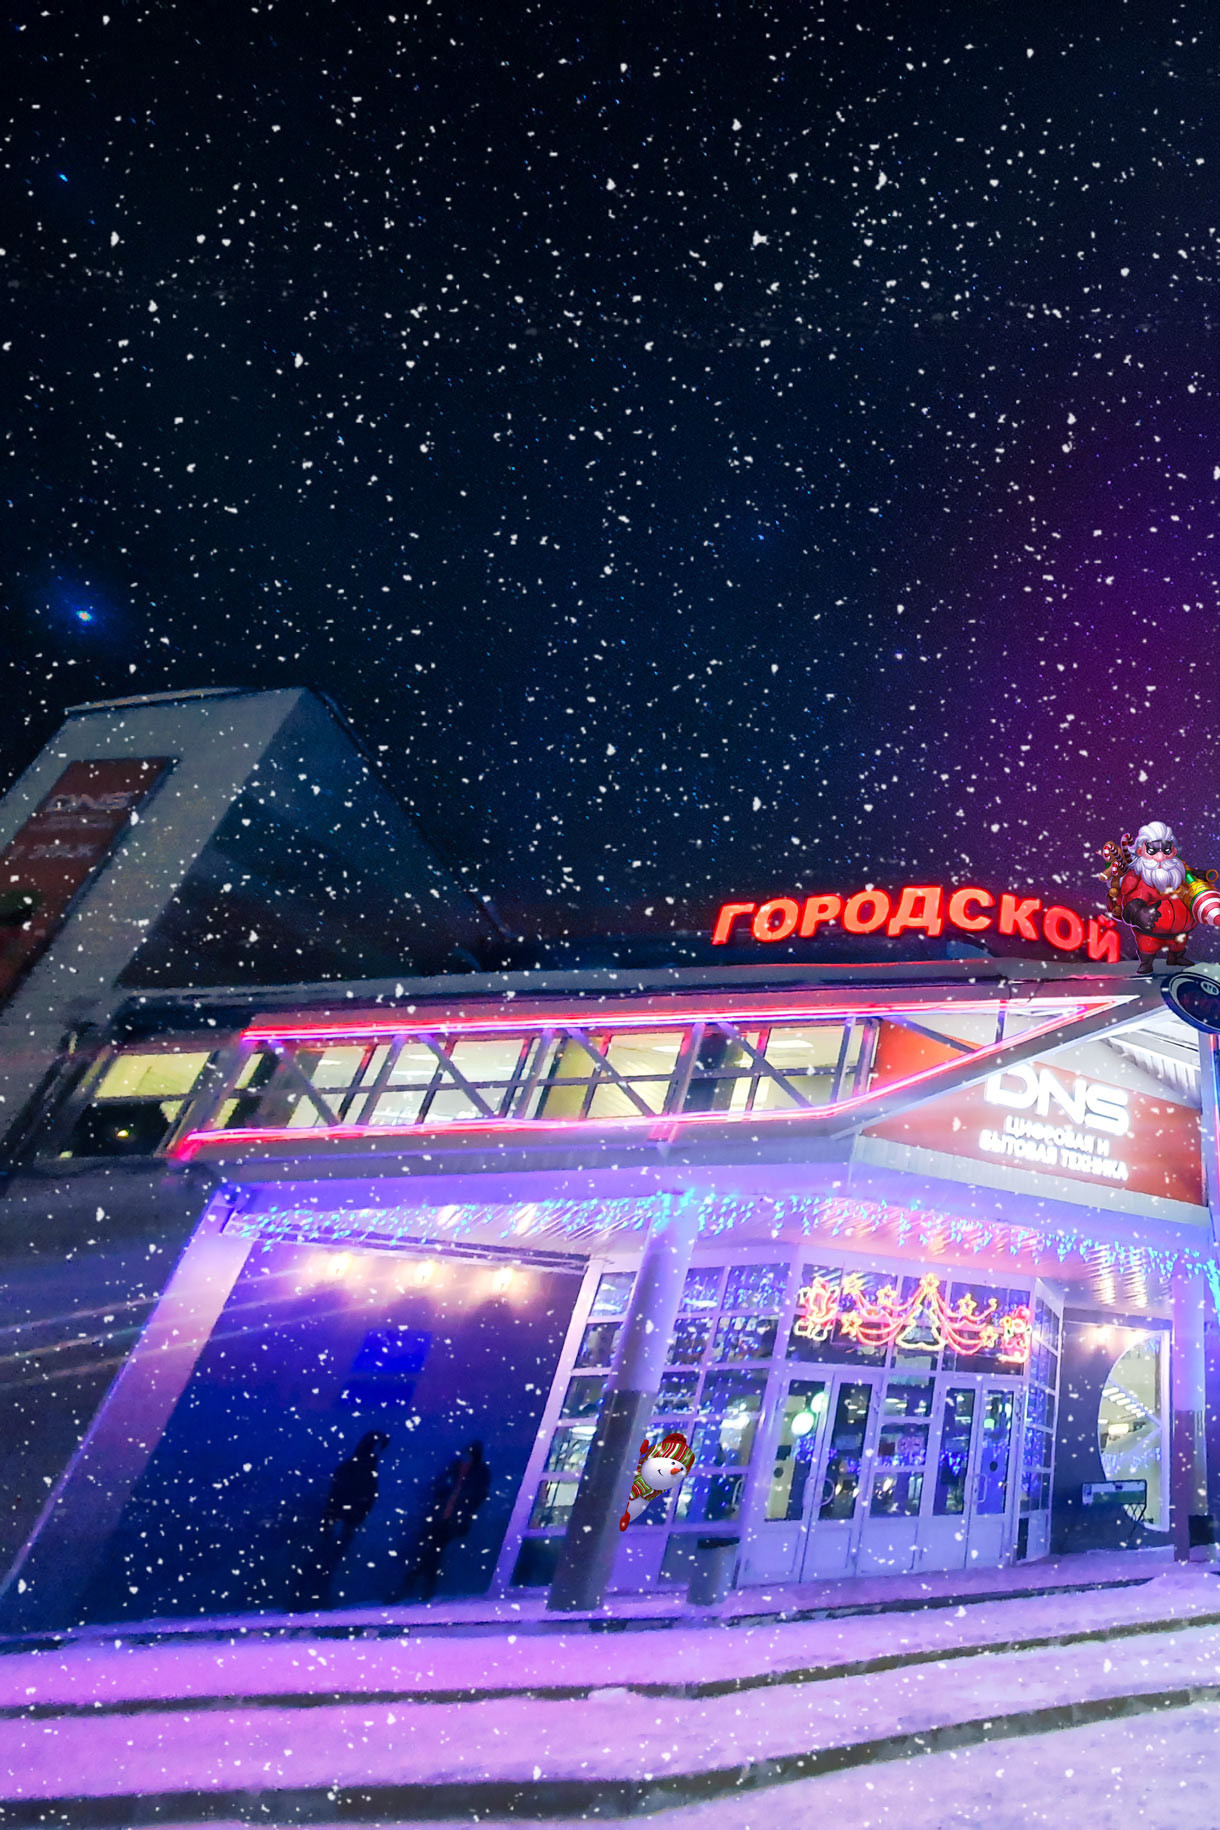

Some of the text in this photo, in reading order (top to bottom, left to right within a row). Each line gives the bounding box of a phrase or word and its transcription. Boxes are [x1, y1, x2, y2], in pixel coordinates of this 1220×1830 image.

[711, 884, 1121, 964] ГОРОДСКОЙ
[984, 1063, 1130, 1137] DNS
[979, 1128, 1130, 1182] БЫТОВАЯ ТЕХНИКА
[1005, 1114, 1110, 1158] ЦИФРОВАЯ И
